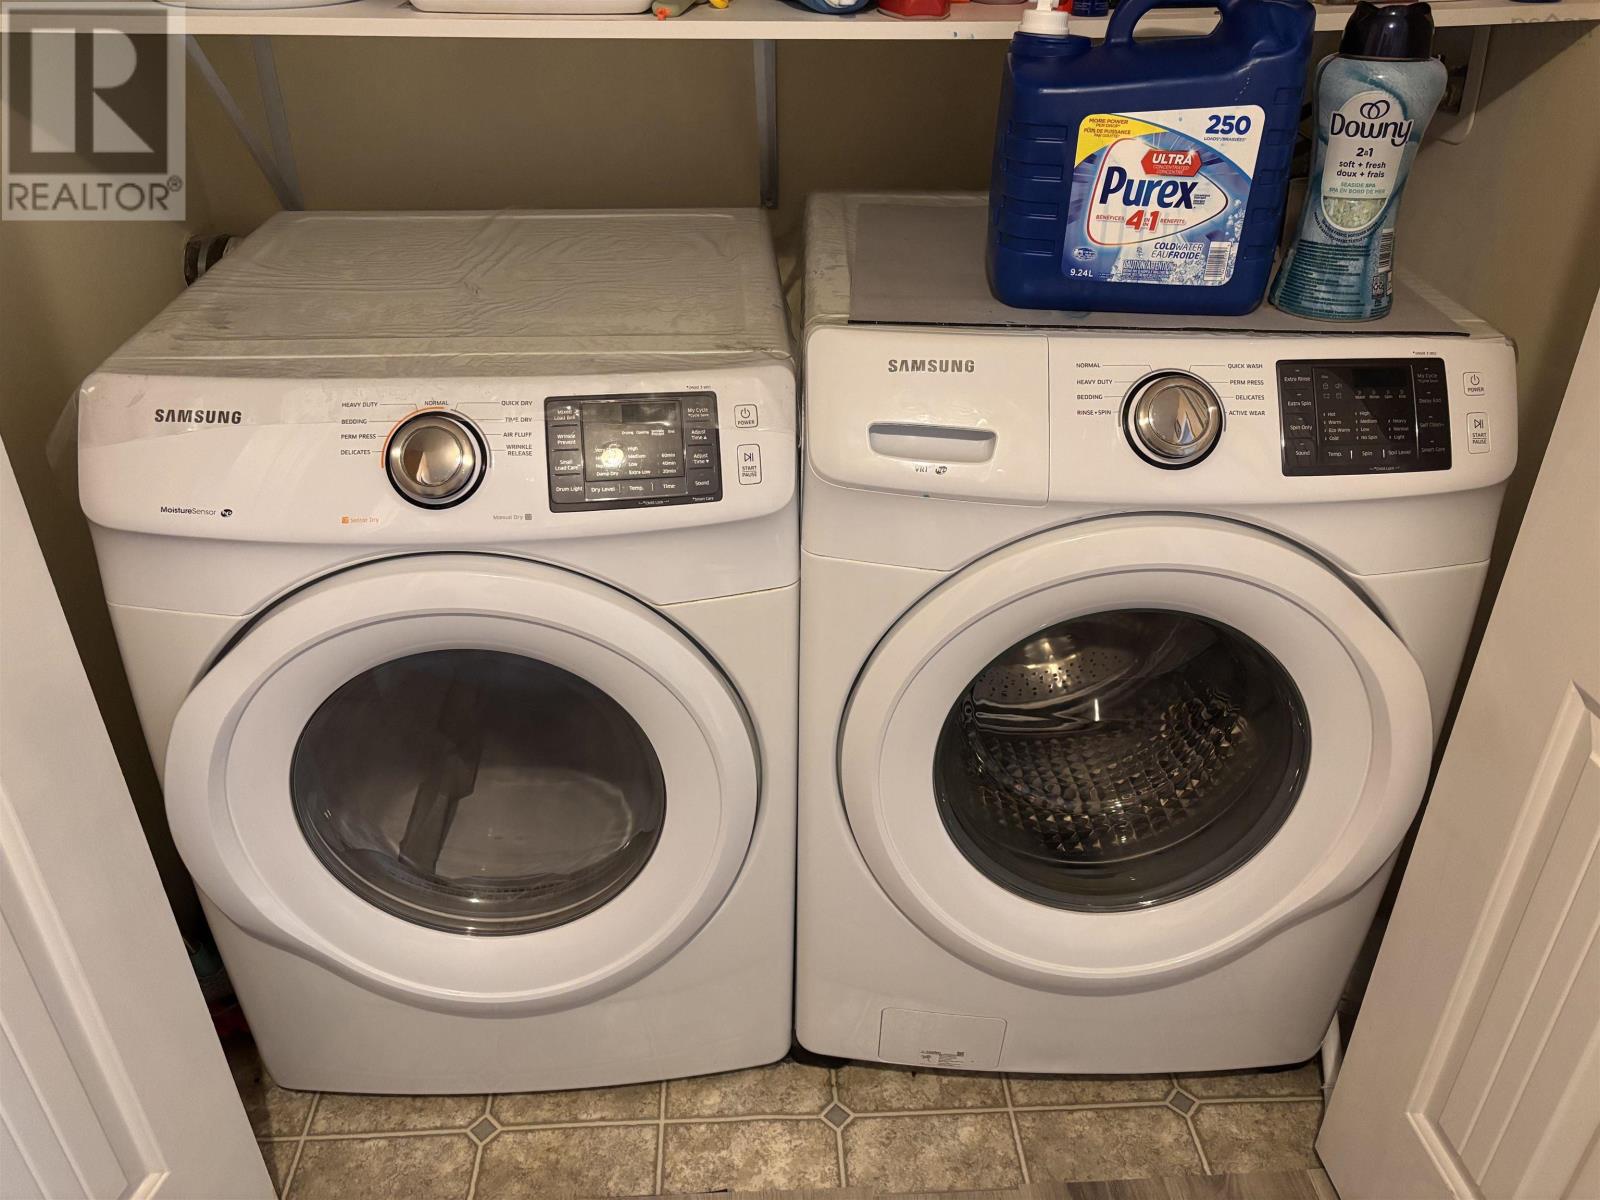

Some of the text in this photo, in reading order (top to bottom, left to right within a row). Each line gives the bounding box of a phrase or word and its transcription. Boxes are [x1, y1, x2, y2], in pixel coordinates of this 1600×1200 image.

[1205, 114, 1252, 136] 250
[1330, 112, 1414, 148] Downy
[1151, 153, 1193, 166] ULTRA
[1339, 160, 1356, 169] soft
[1365, 161, 1386, 170] fresh
[1336, 169, 1357, 178] doux
[1366, 170, 1385, 179] frais
[1100, 166, 1198, 210] Purex
[1125, 209, 1144, 231] 4
[1148, 210, 1160, 232] 1
[888, 359, 975, 373] SAMSUNG
[154, 408, 242, 425] SAMSUNG
[160, 506, 217, 516] MoistureSensor
